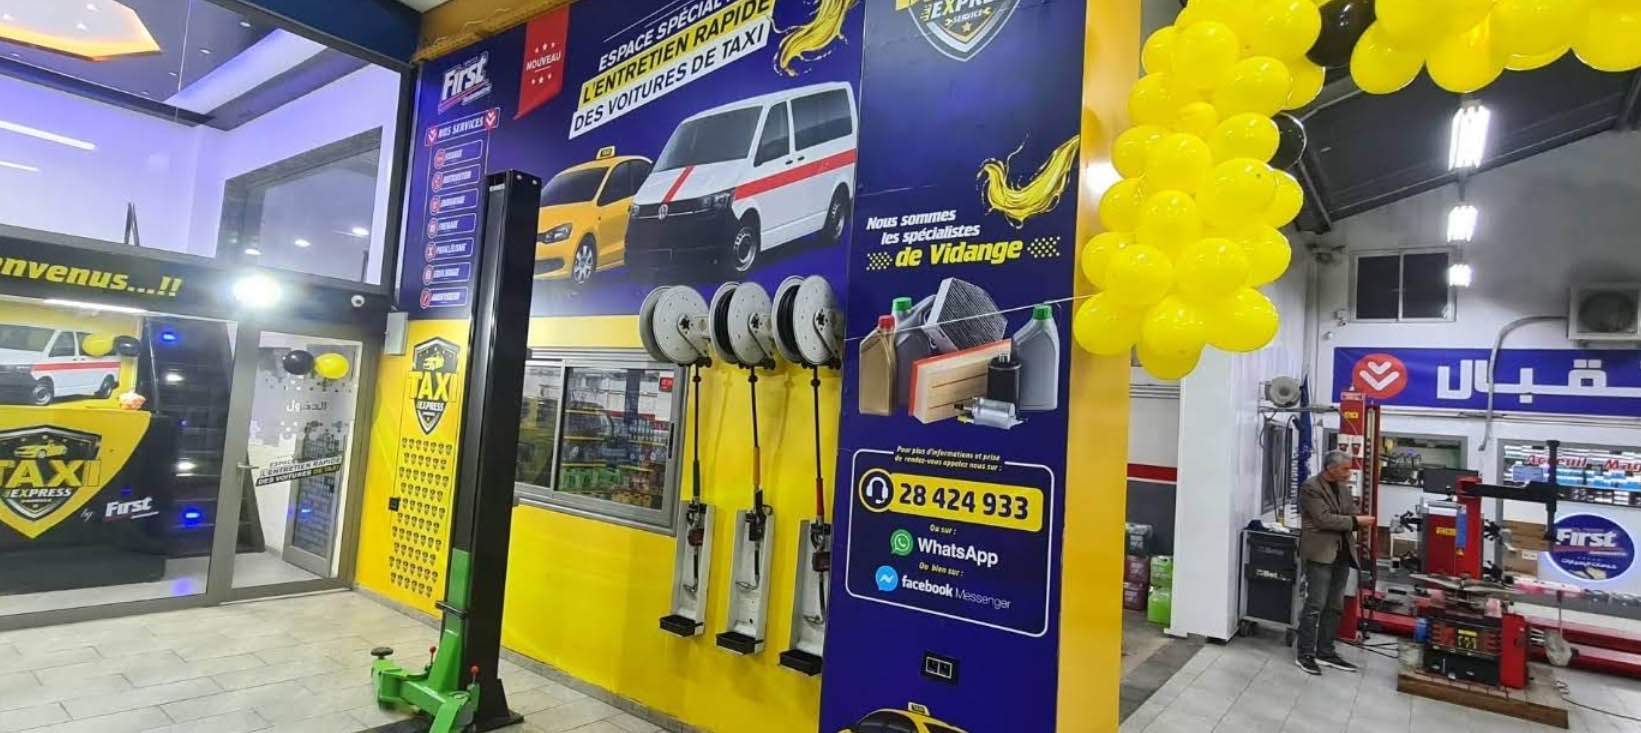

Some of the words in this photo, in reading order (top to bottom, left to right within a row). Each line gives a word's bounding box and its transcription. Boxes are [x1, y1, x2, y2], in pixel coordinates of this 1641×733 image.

[599, 29, 653, 72] ESPACE
[656, 0, 722, 40] SPÉCIAL
[526, 51, 561, 71] NOUVEAU
[583, 34, 689, 104] L'ENTRETIEN
[693, 0, 770, 50] RAPIDE
[441, 52, 488, 101] First
[573, 105, 603, 132] DES
[608, 63, 687, 115] VOITURES
[691, 48, 717, 74] DE
[722, 24, 764, 59] TAXI
[452, 116, 484, 135] SERVICES
[866, 216, 898, 230] Nous
[900, 209, 956, 226] sommes
[881, 232, 899, 245] les
[903, 223, 980, 245] spécialistes
[895, 246, 923, 267] de
[930, 240, 1023, 264] Vidange
[0, 257, 183, 297] nvenus...!!
[408, 370, 458, 402] TAXI
[1437, 359, 1641, 404] قبال
[896, 446, 911, 454] Pour
[911, 447, 926, 455] plus
[926, 448, 973, 459] d'informations
[982, 454, 1000, 462] prise
[904, 456, 942, 465] rendez-vous
[943, 459, 968, 469] appelez
[0, 459, 101, 488] TAXI
[10, 488, 73, 498] EXPRESS
[900, 483, 926, 506] 28
[932, 487, 975, 512] 424
[982, 493, 1028, 520] 933
[80, 508, 94, 522] by
[105, 497, 152, 518] First
[930, 524, 940, 532] Ou
[941, 527, 953, 535] sur
[1556, 528, 1617, 547] First
[917, 537, 998, 568] WhatsApp
[919, 562, 930, 571] Ou
[931, 563, 946, 573] bien
[947, 567, 960, 576] sur
[901, 575, 953, 597] facebook
[955, 587, 1012, 609] Messenger
